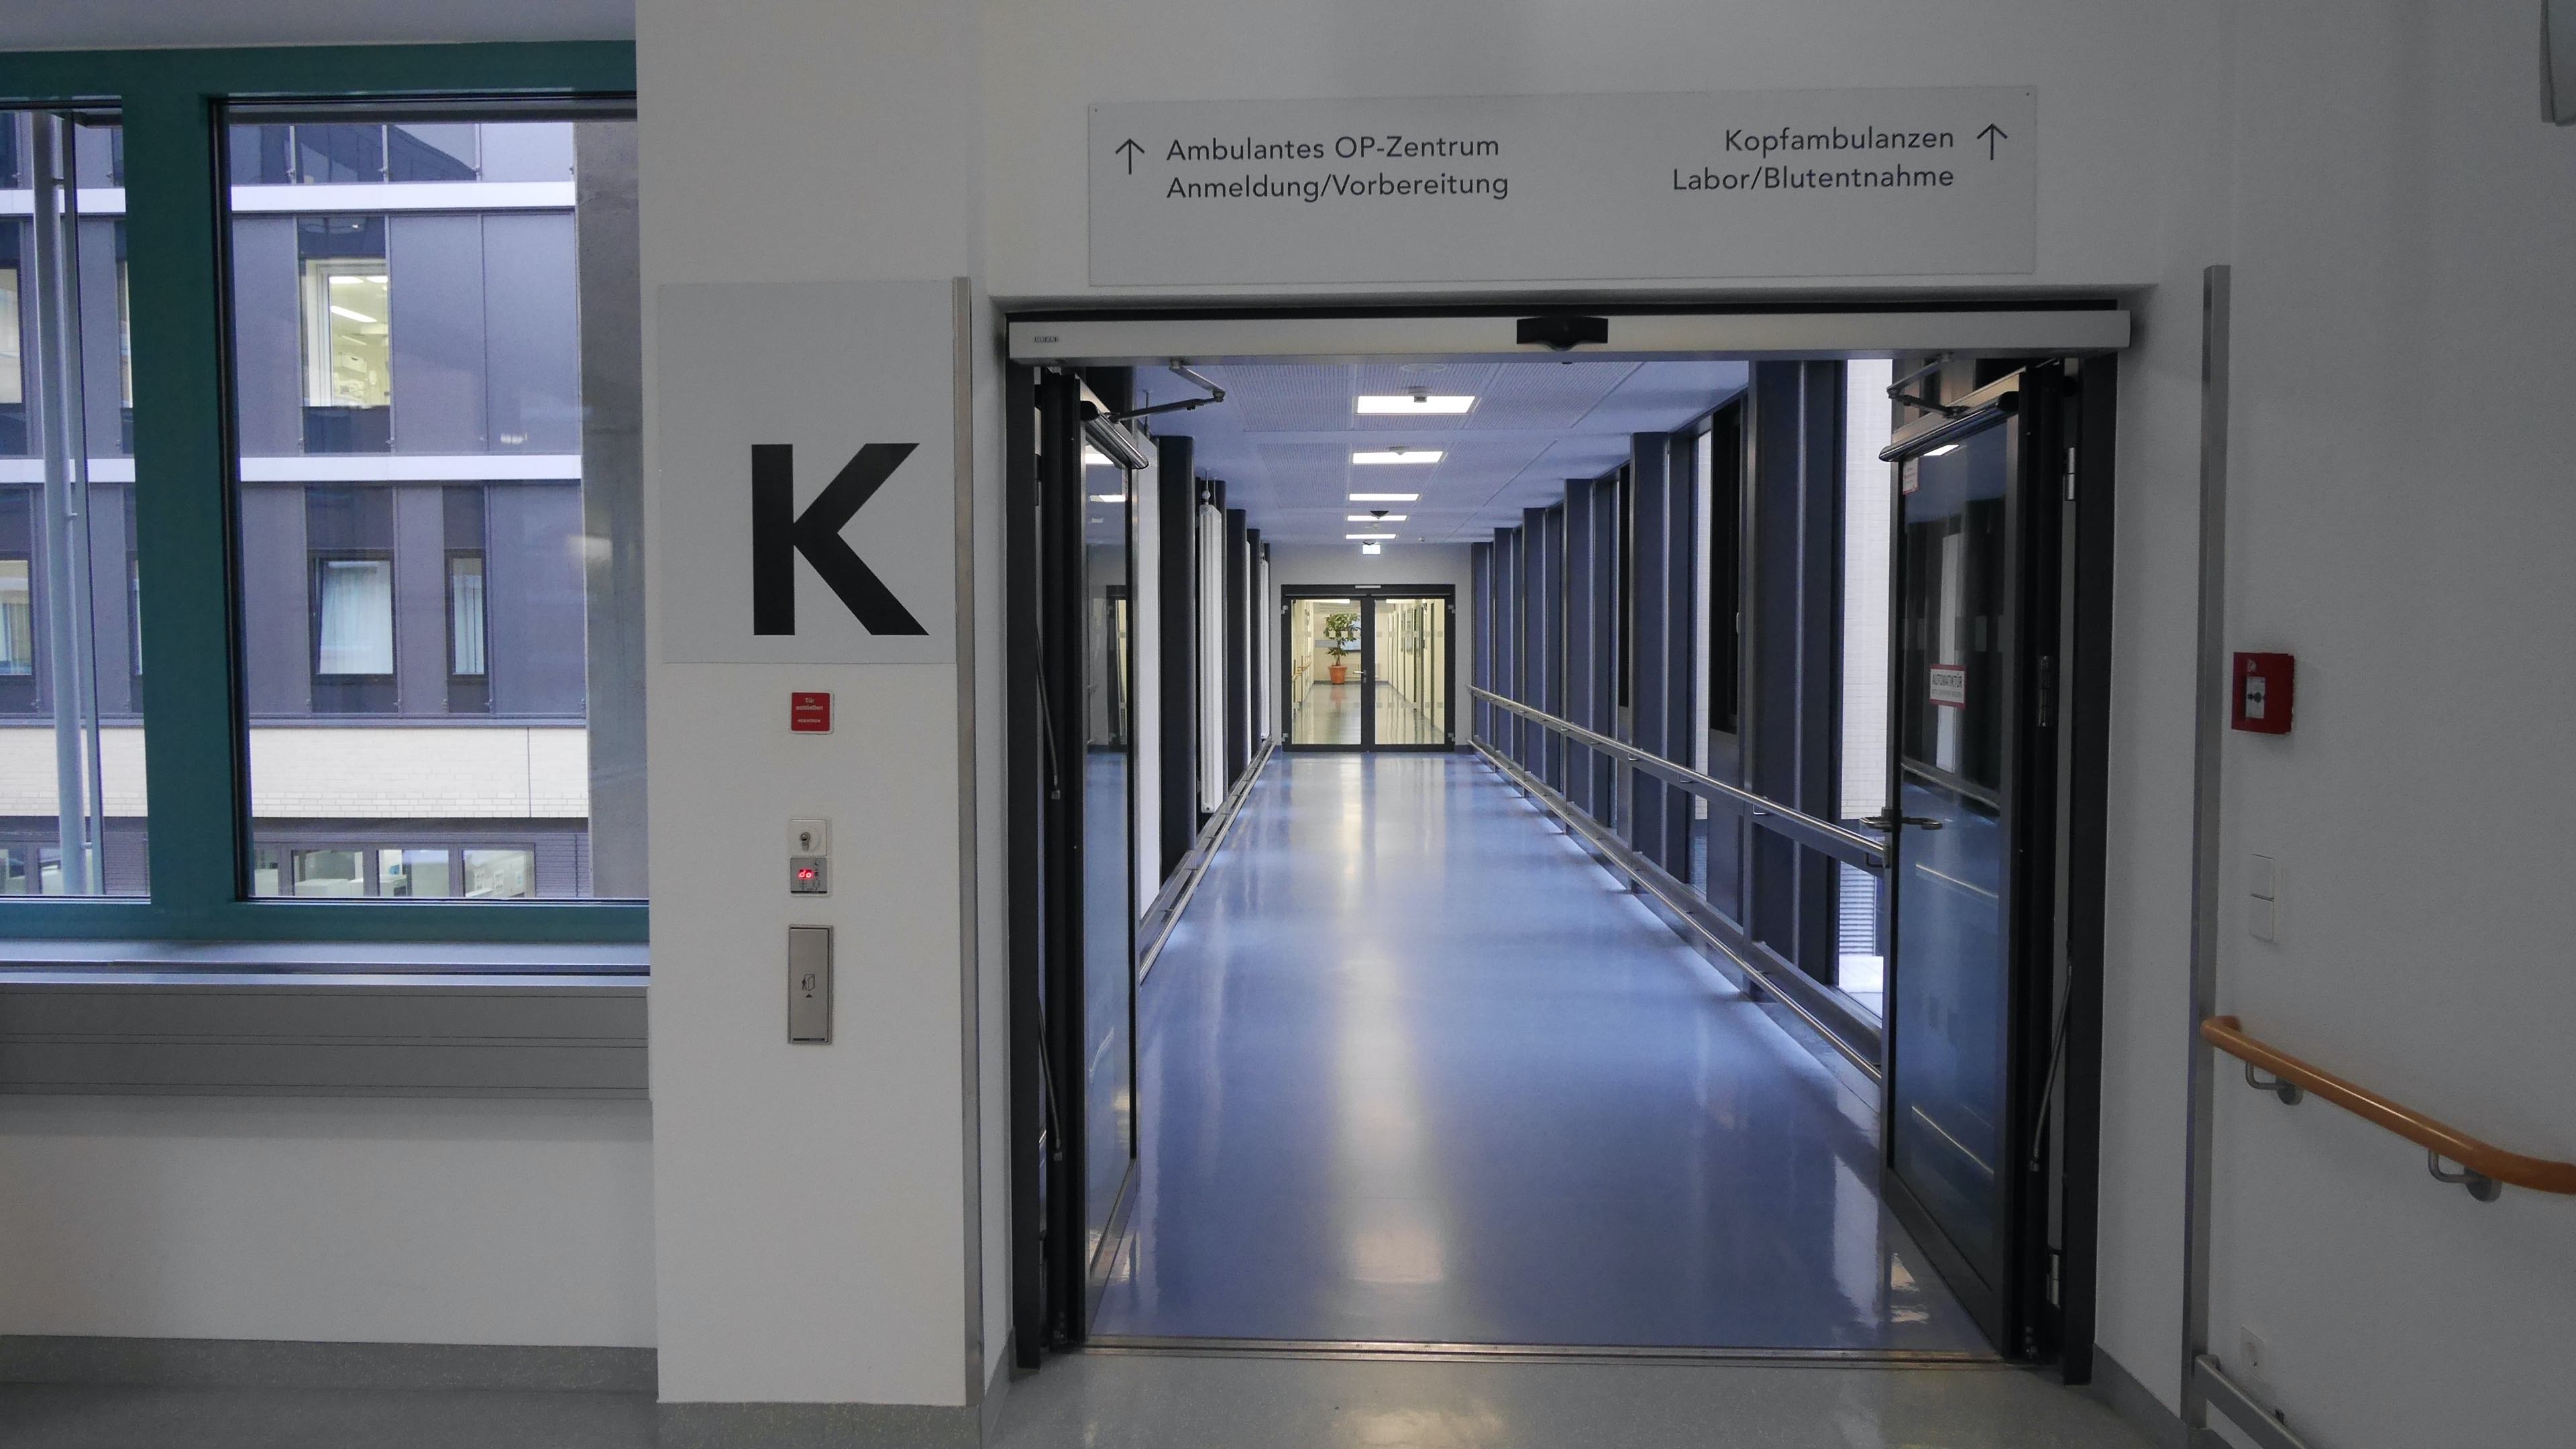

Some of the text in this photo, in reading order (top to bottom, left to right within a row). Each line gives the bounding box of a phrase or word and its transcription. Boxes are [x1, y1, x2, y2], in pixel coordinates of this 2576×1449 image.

[1166, 136, 1499, 161] Ambulantes OP-Zentrum
[1725, 125, 1953, 158] Kopfambulanzen
[1166, 172, 1508, 203] Anmeldung/Vorbereitung
[1674, 164, 1954, 191] Labor/Blutentnahme
[751, 442, 930, 636] K
